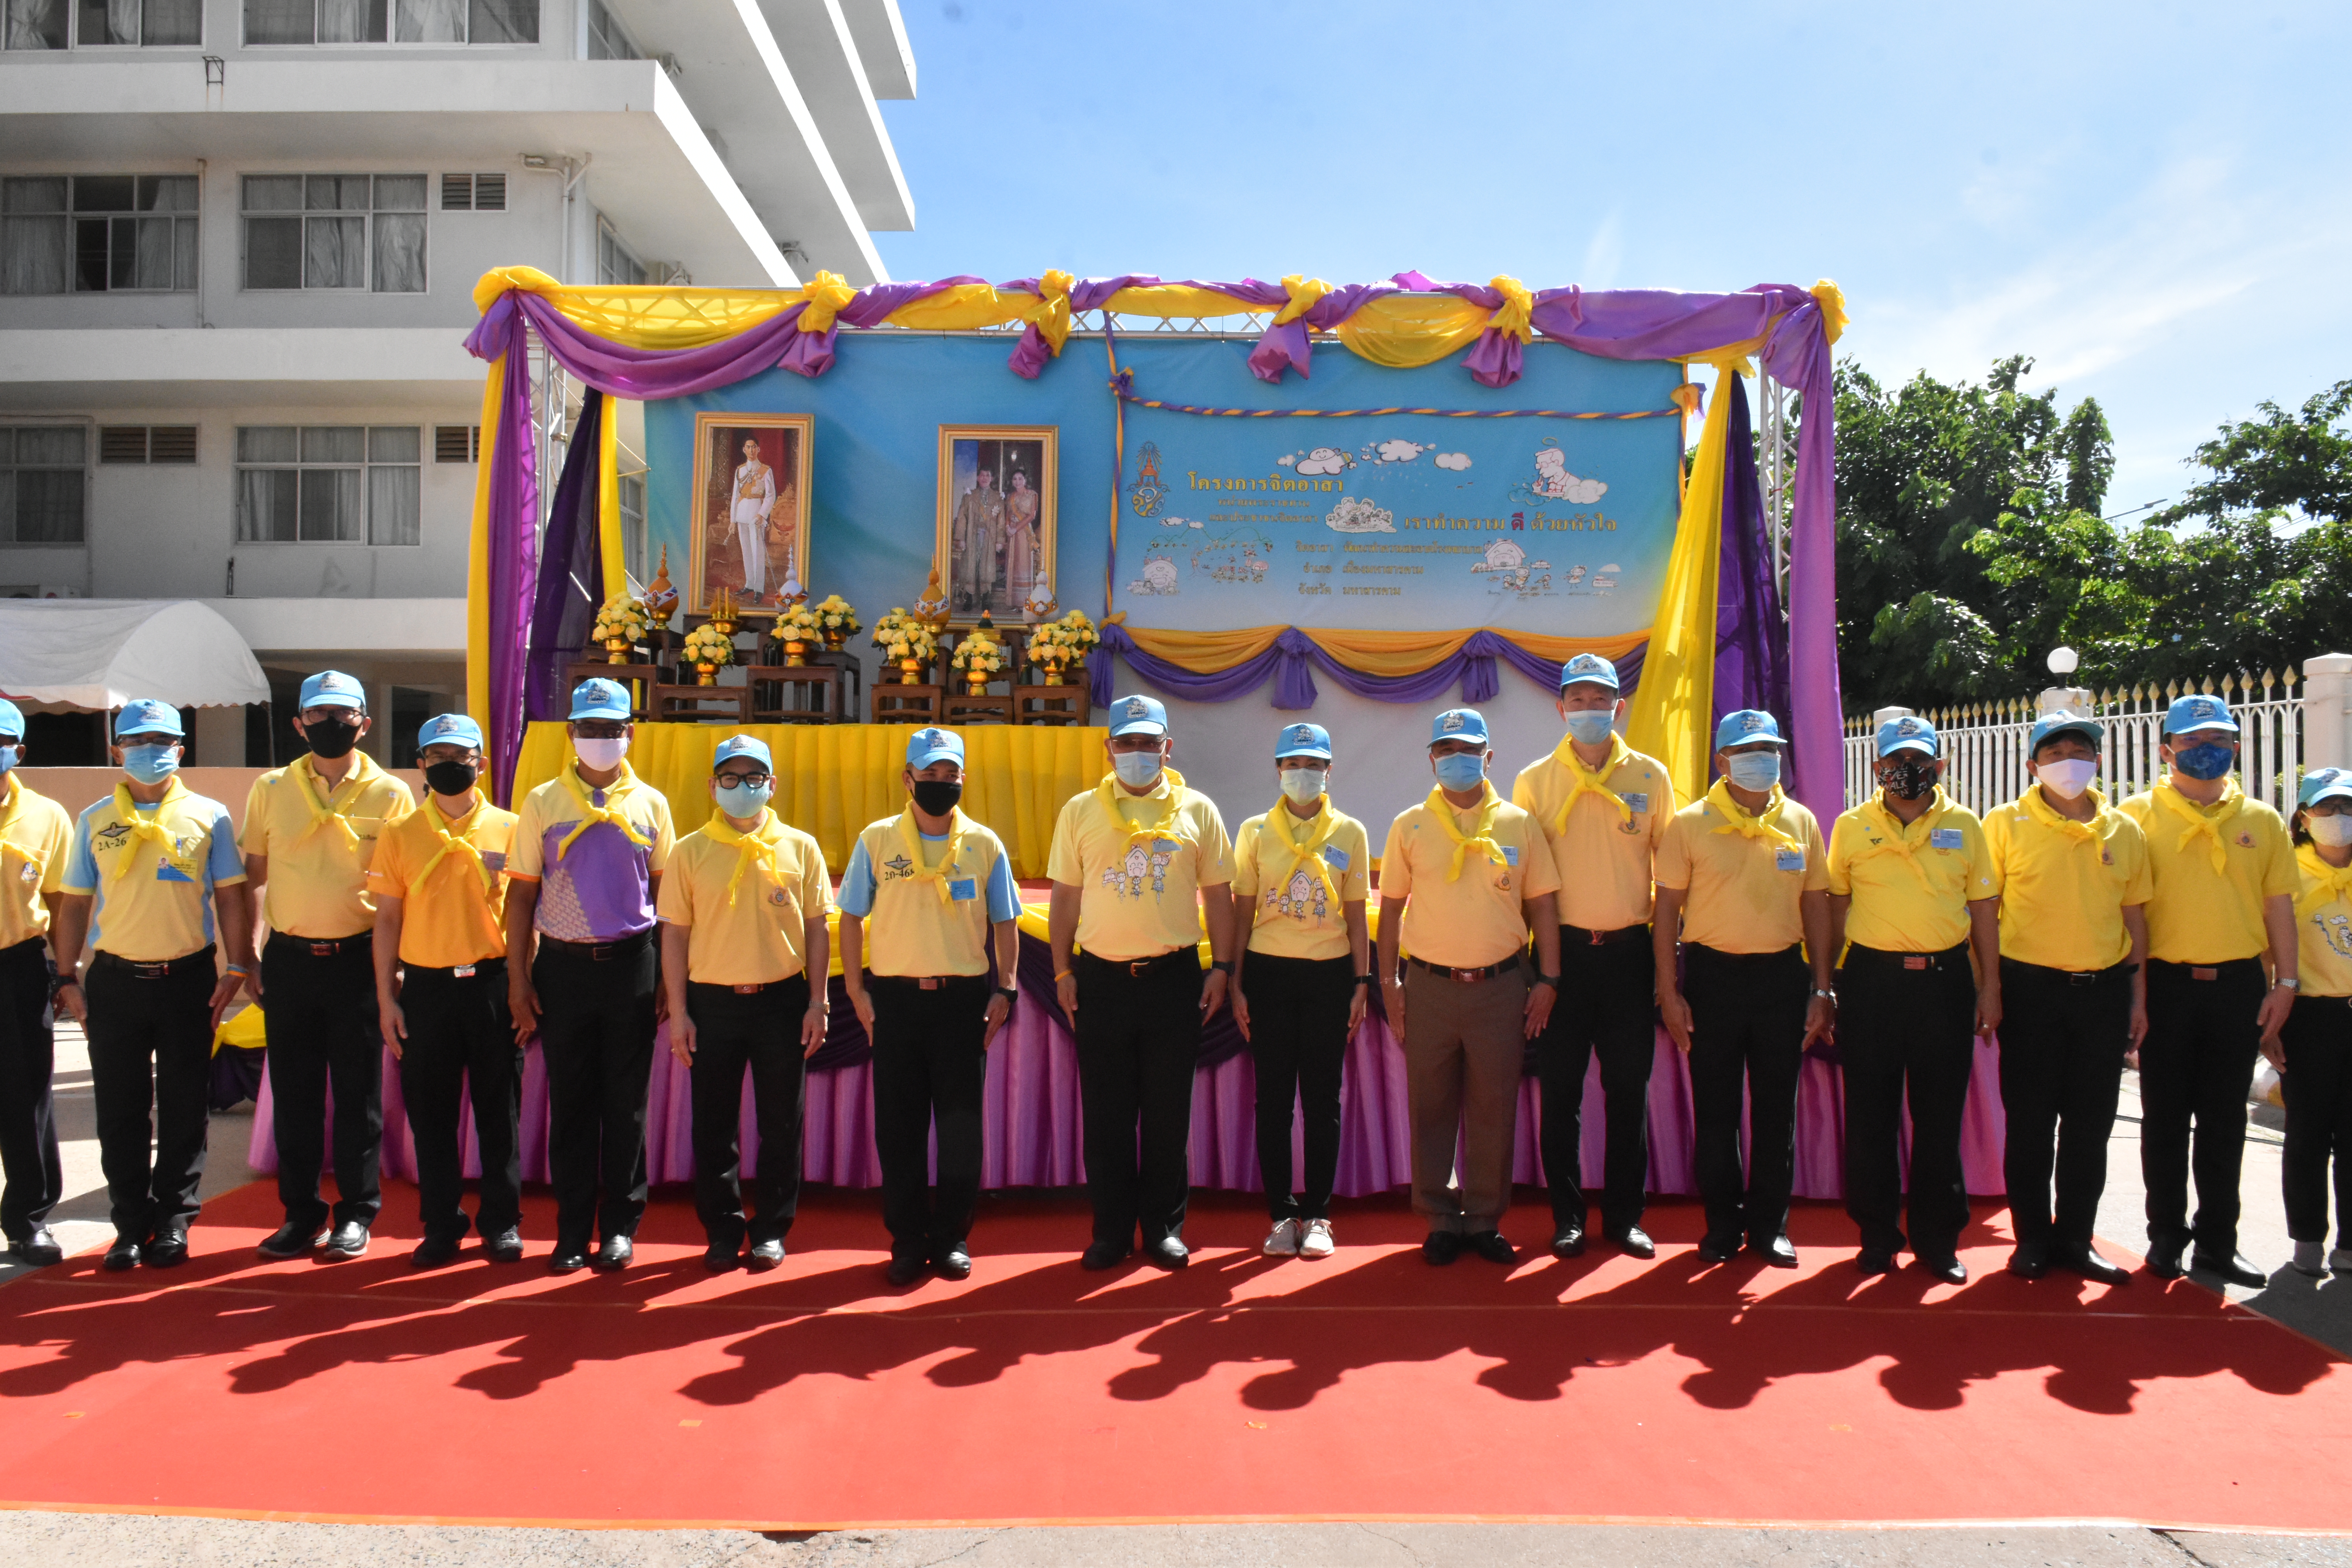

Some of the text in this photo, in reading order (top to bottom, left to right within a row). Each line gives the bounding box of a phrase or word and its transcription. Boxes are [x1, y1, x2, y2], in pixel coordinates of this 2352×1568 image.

[1187, 471, 1343, 492] โครงการจิตอาสา
[1404, 511, 1617, 531] เราทำความ ดี ด้วยหัวใจ
[98, 837, 129, 851] 2A-26
